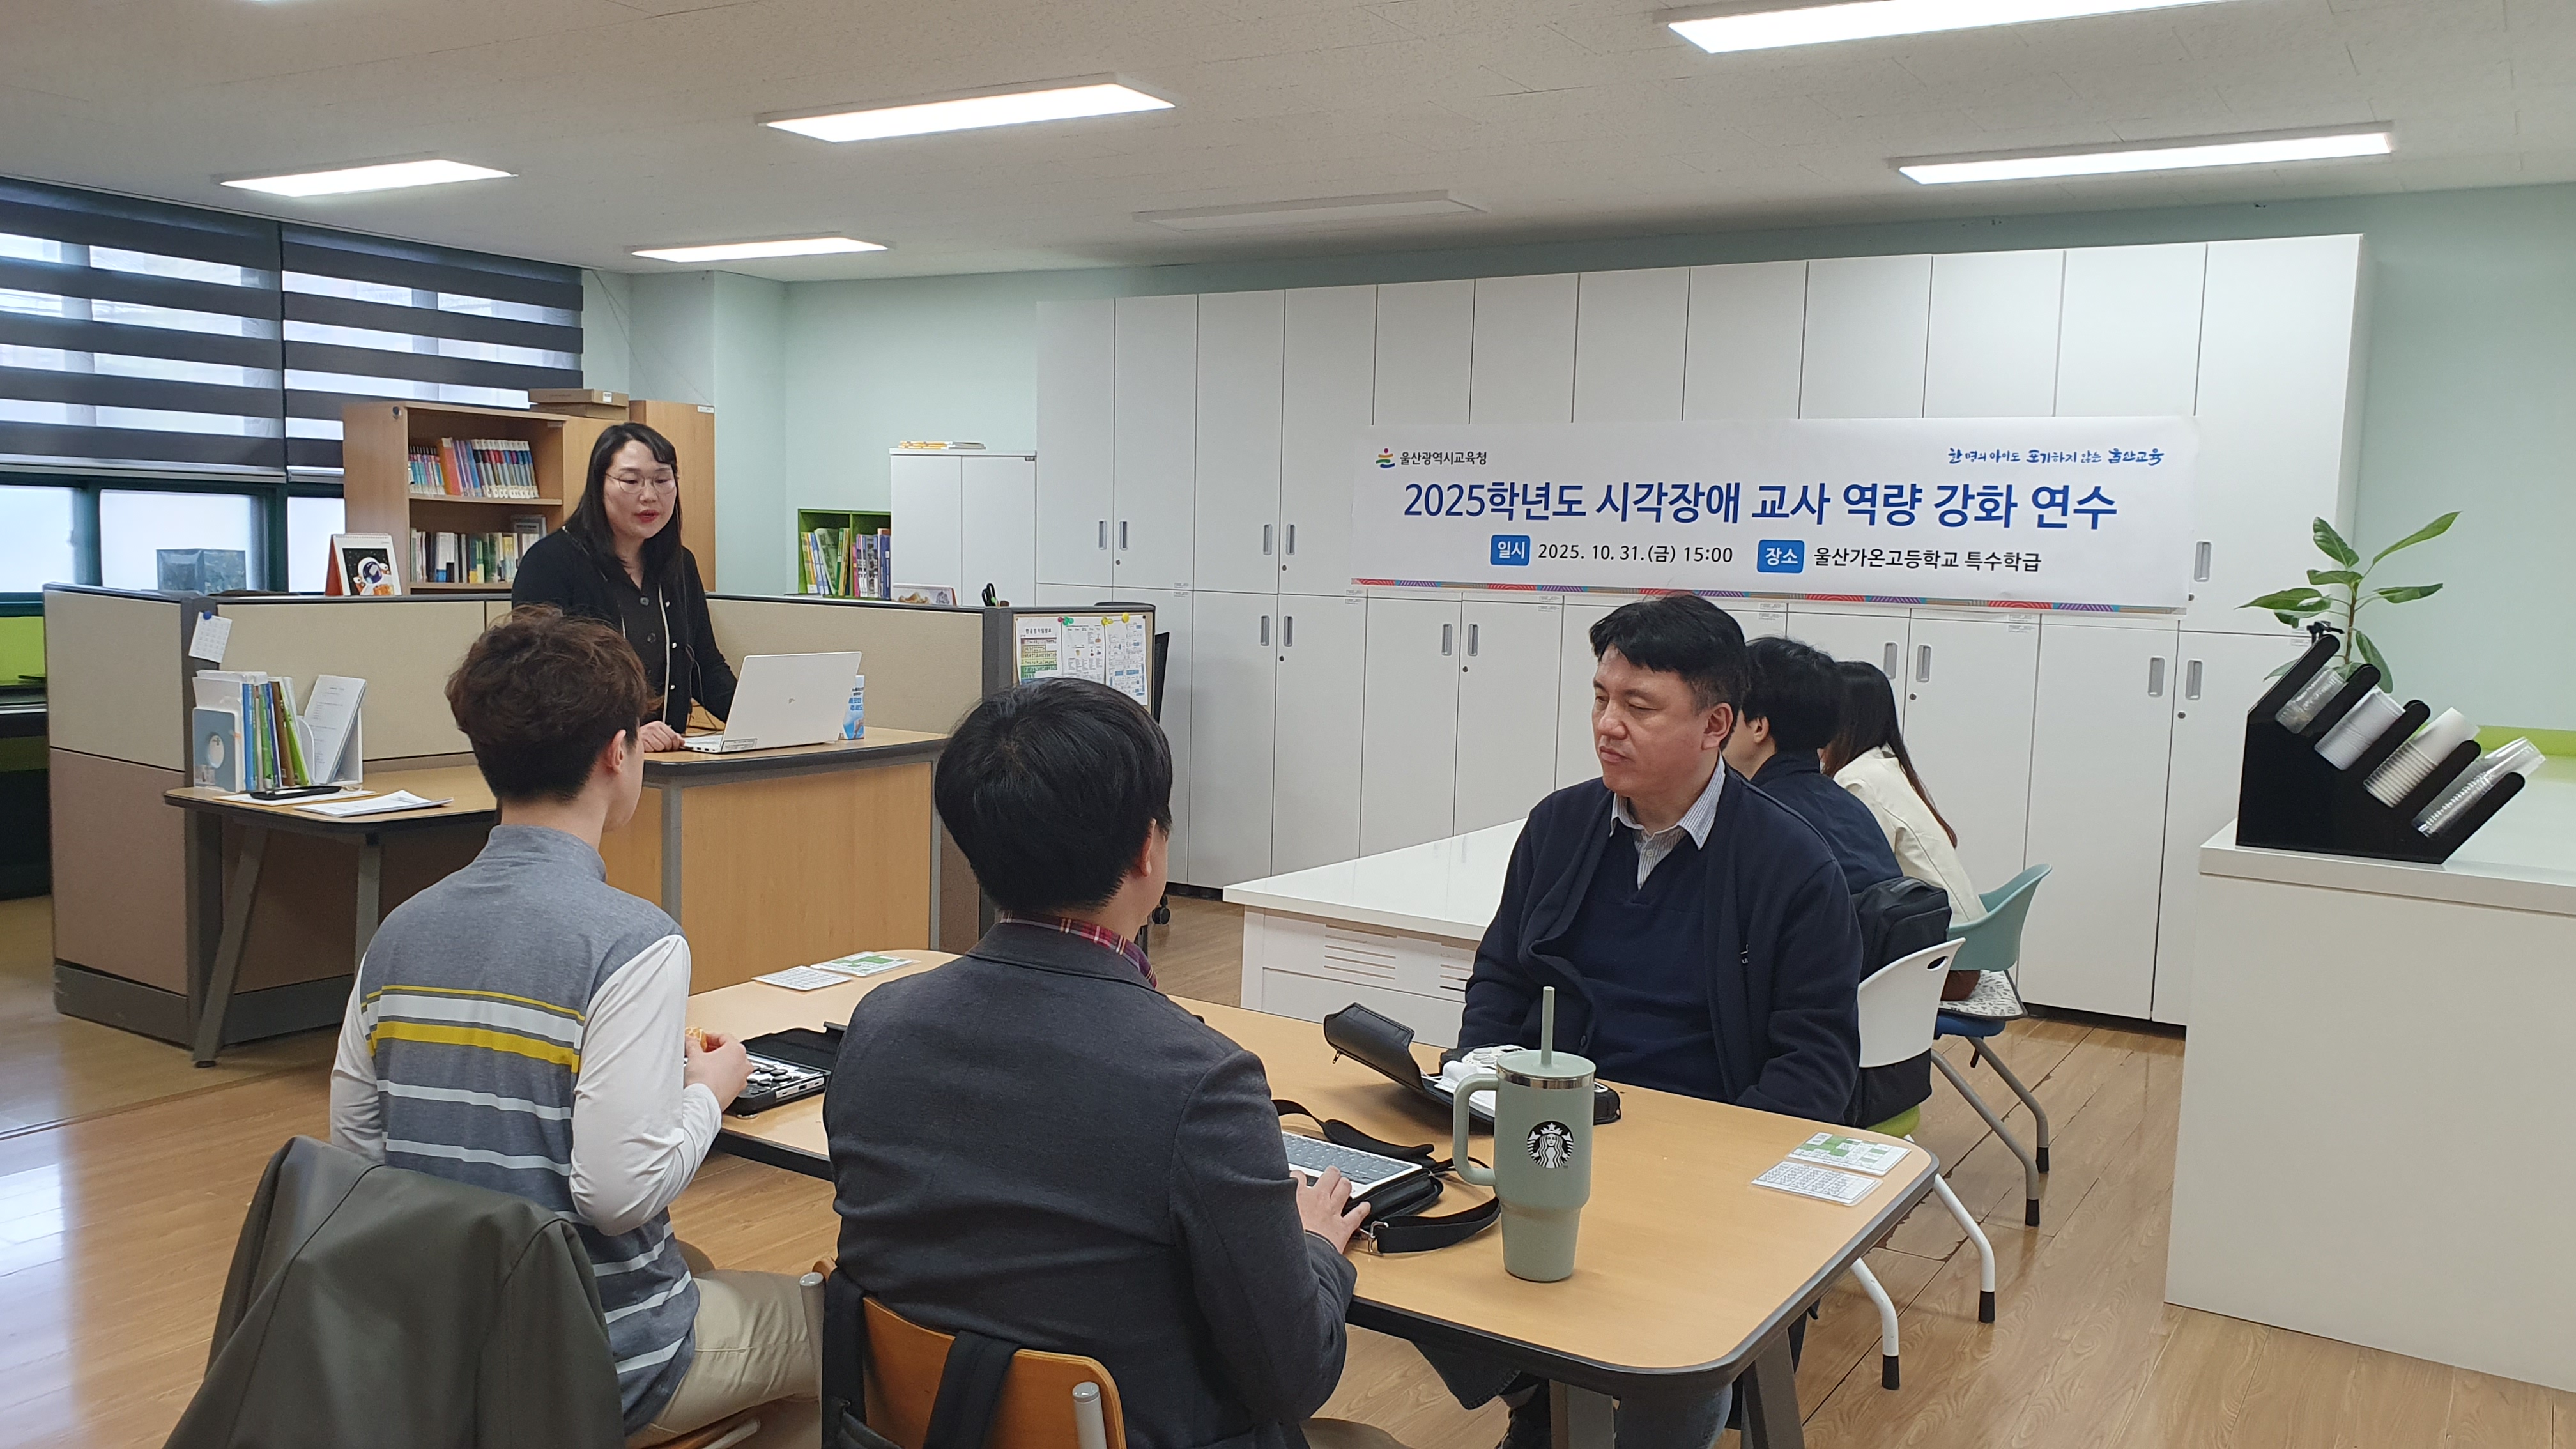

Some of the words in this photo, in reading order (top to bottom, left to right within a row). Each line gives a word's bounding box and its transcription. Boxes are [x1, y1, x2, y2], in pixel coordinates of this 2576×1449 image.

[1399, 450, 1487, 466] 울산광역시교육청
[1947, 447, 1963, 464] 한
[1965, 450, 1987, 463] 명의
[1989, 448, 2021, 463] 아이도
[2026, 449, 2077, 464] 포기하지
[2080, 450, 2102, 464] 않는
[2108, 448, 2165, 466] 울산교육
[1404, 482, 1587, 521] 2025학년도
[1595, 482, 1740, 524] 시각장애
[1751, 482, 1831, 525] 교사
[1843, 482, 1923, 527] 역량
[1933, 483, 2018, 528] 강화
[2031, 484, 2117, 530] 연수
[1497, 540, 1526, 560] 일시
[1538, 544, 1584, 560] 2025.
[1592, 544, 1614, 560] 10.
[1620, 544, 1676, 564] 31.(금)
[1684, 546, 1733, 563] 15:00
[1764, 547, 1799, 566] 장소
[1813, 547, 1959, 570] 울산가온고등학교
[1964, 551, 2042, 573] 특수학급
